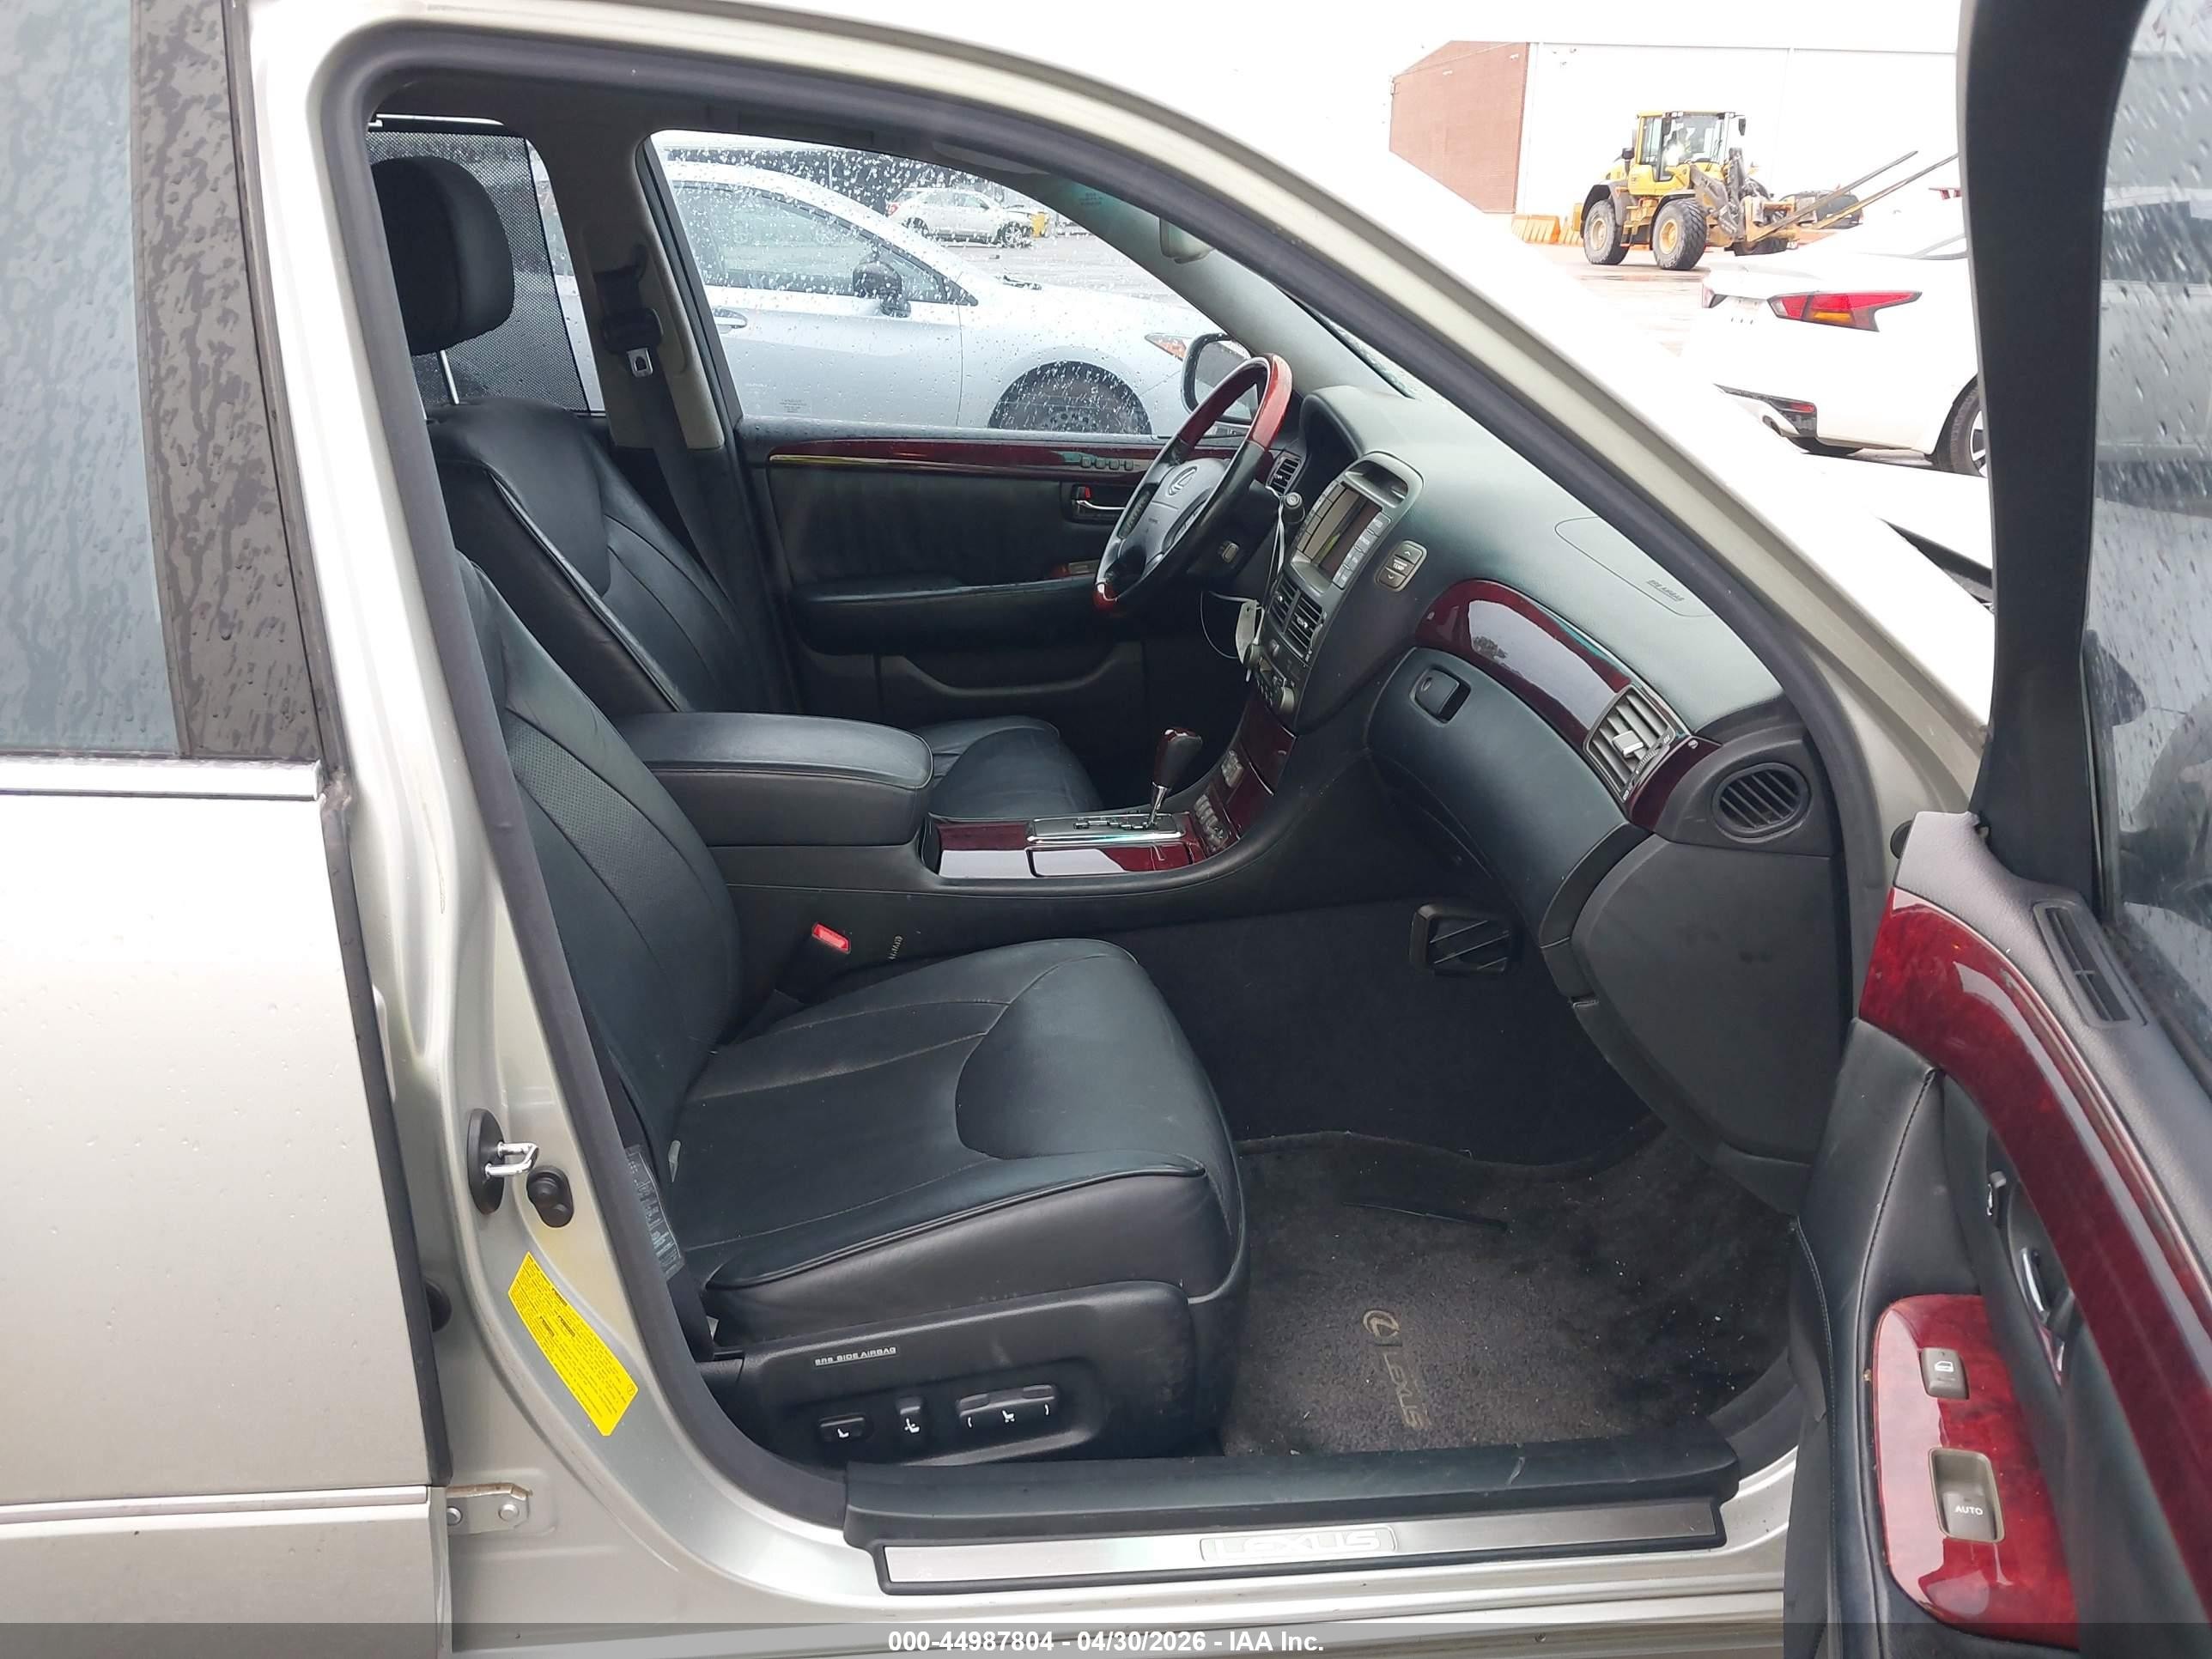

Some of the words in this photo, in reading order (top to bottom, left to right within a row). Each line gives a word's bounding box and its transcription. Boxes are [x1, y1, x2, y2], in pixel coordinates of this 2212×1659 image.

[836, 1352, 860, 1361] SIDE
[860, 1346, 896, 1358] AIRBAG
[1954, 1505, 1983, 1516] AUTO
[1213, 1531, 1380, 1559] LEXUS
